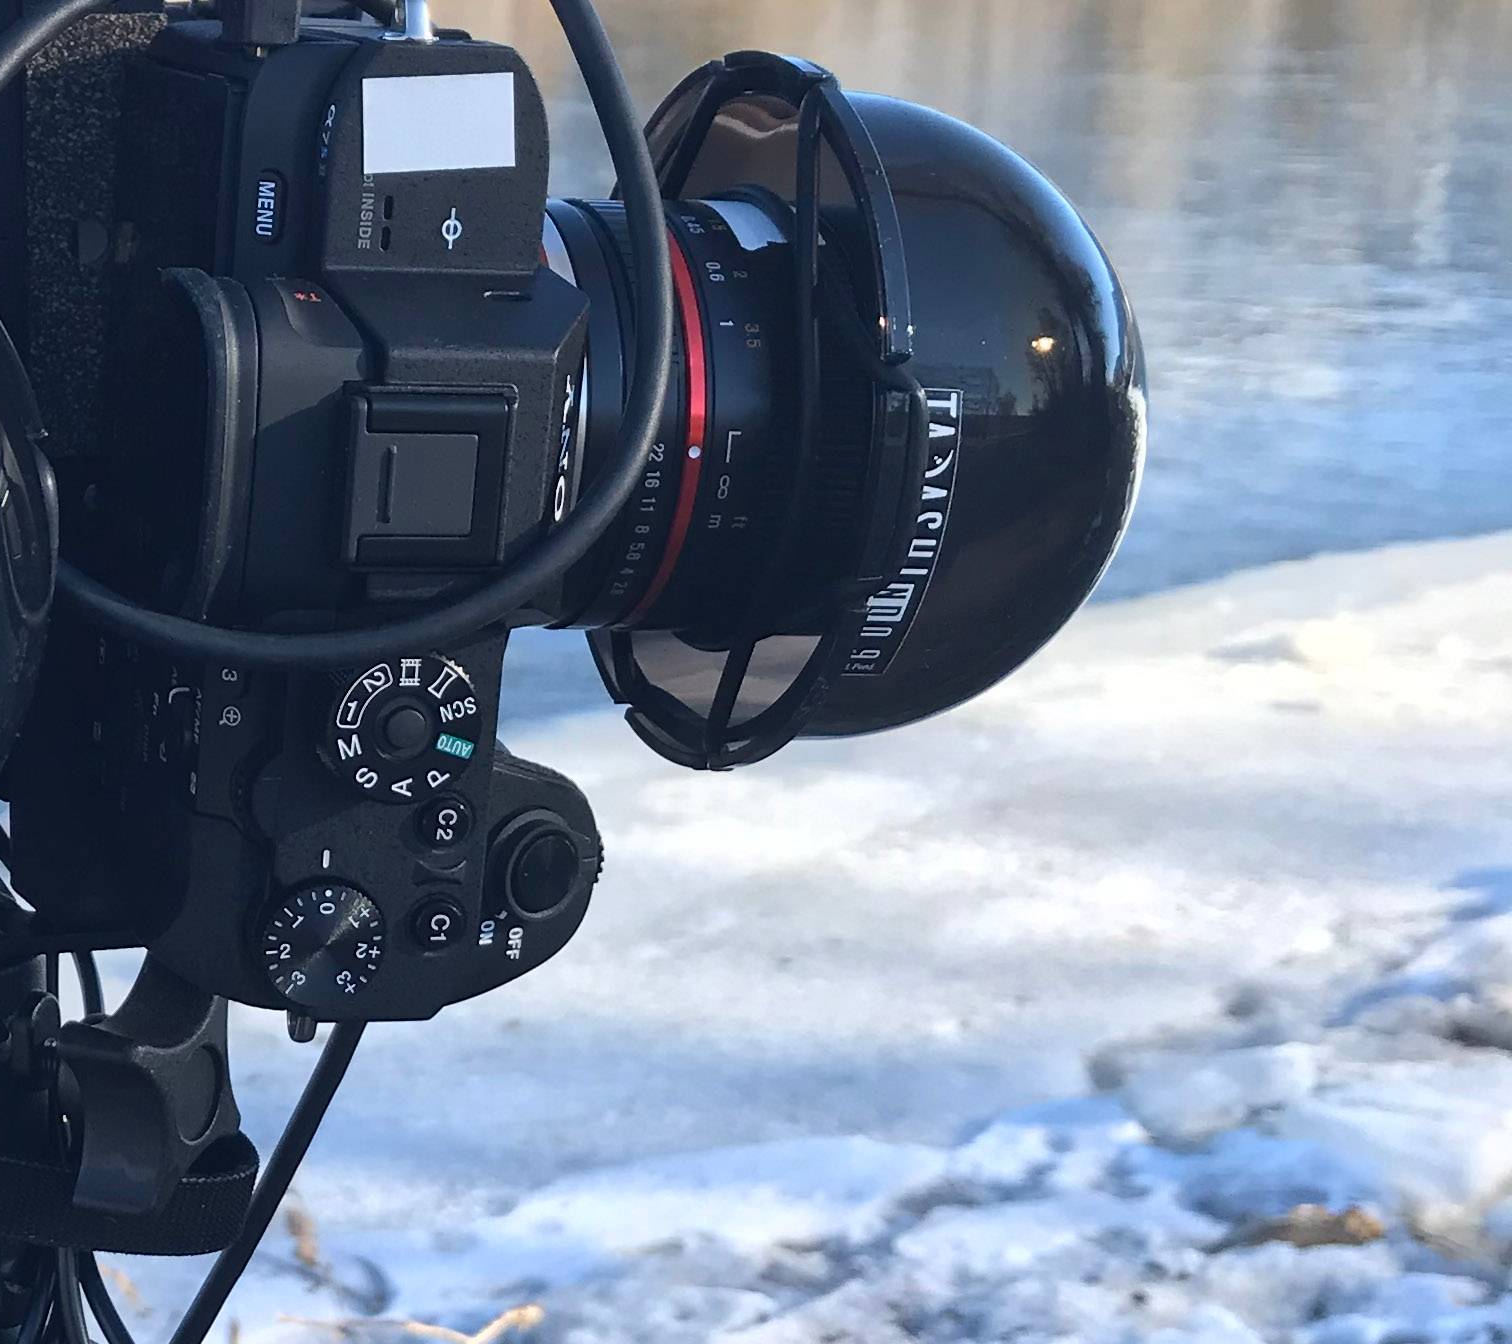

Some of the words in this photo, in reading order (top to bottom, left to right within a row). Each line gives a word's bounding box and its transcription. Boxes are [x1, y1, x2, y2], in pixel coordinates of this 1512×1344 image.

[255, 181, 276, 236] MENU
[357, 193, 375, 249] INSIDE
[705, 261, 725, 283] 0.6
[649, 444, 665, 463] 22
[644, 470, 661, 489] 16
[640, 497, 656, 513] 11
[634, 525, 650, 535] 8
[346, 701, 358, 722] 1
[363, 671, 386, 693] 2
[439, 697, 477, 723] SCN
[337, 734, 363, 760] M
[437, 735, 473, 757] AUTO
[355, 767, 378, 788] S
[391, 777, 413, 797] A
[426, 769, 450, 788] P
[436, 809, 458, 841] C2
[319, 902, 336, 915] 0
[429, 914, 451, 941] C1
[479, 920, 496, 946] ON
[505, 926, 524, 960] OFF
